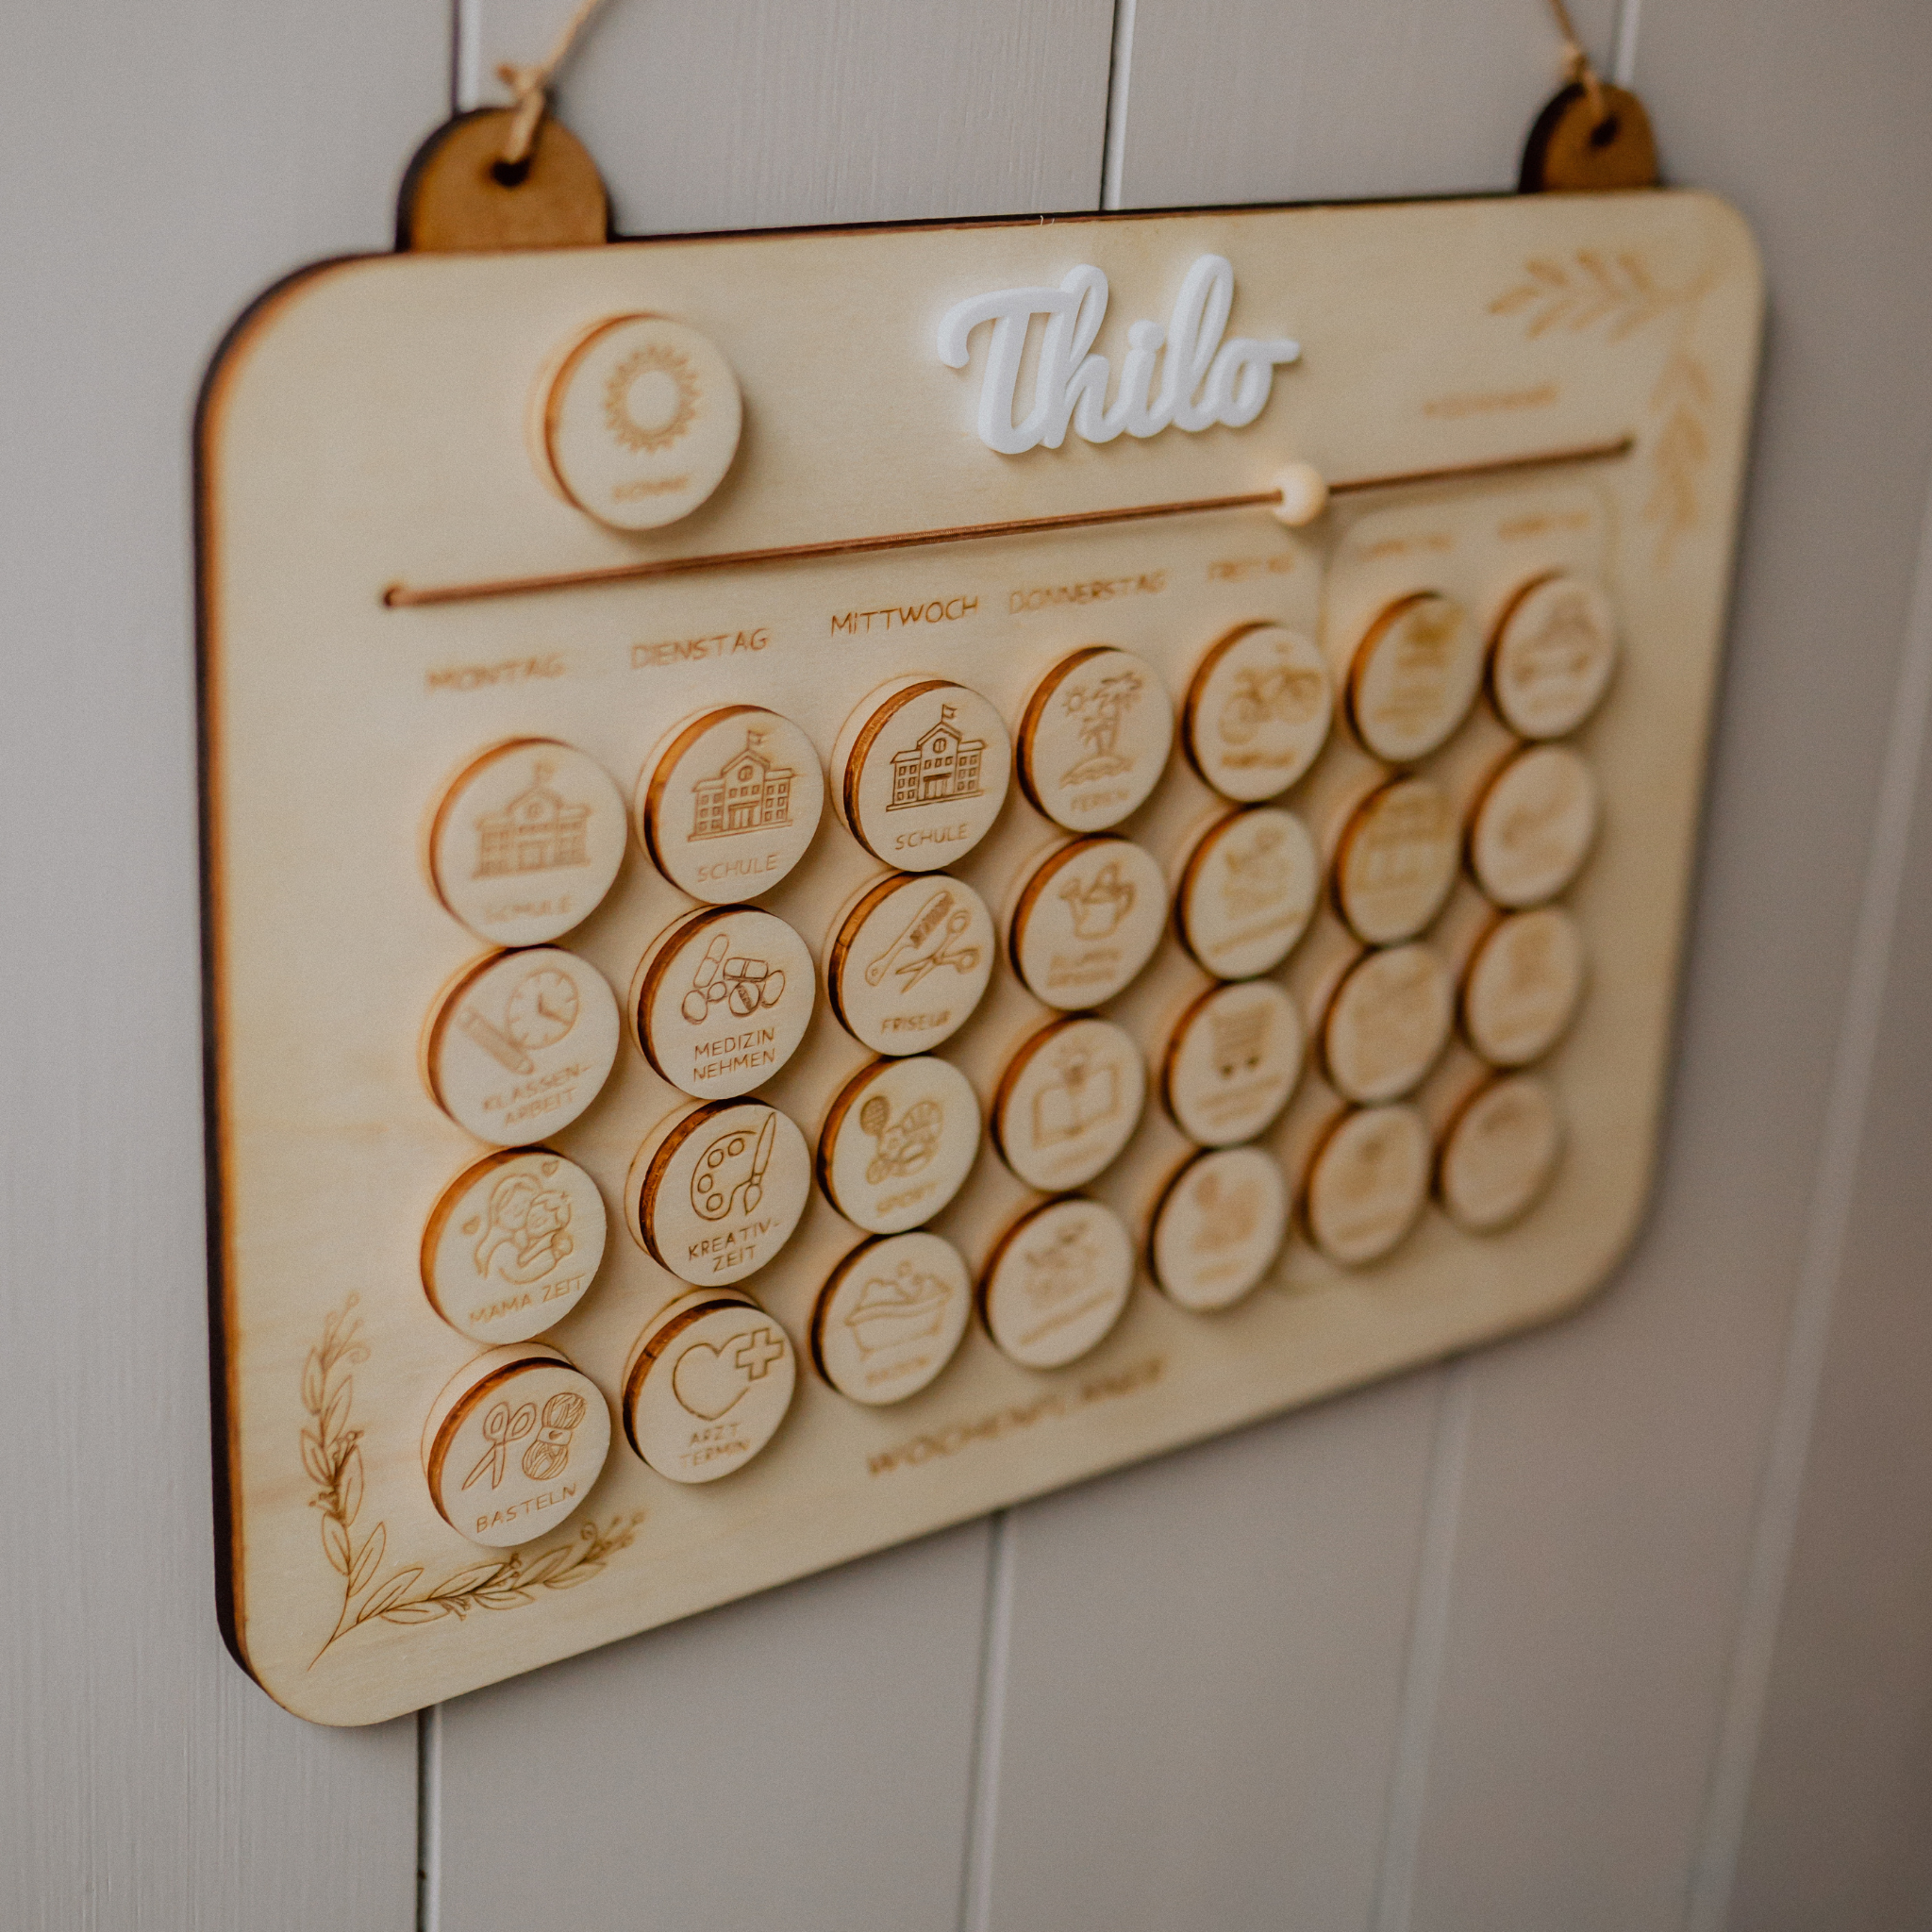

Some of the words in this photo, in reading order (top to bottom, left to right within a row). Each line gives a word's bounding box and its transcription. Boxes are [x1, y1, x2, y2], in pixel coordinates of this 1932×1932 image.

[936, 253, 1301, 456] Thilo
[830, 594, 979, 638] MITTWOCH
[630, 627, 771, 671] DIENSTAG
[895, 823, 969, 851] SCHULE
[697, 853, 779, 884] SCHULE
[693, 1026, 776, 1061] MEDIZIN
[692, 1048, 776, 1083] NEHMEN
[504, 1086, 576, 1129] ARBEIT
[687, 1220, 781, 1262] KREATIV-
[711, 1244, 758, 1274] ZEIT
[469, 1292, 533, 1324] MAMA
[541, 1273, 588, 1304] ZEIT
[689, 1422, 741, 1447] ARZT
[475, 1482, 577, 1534] BASTELN
